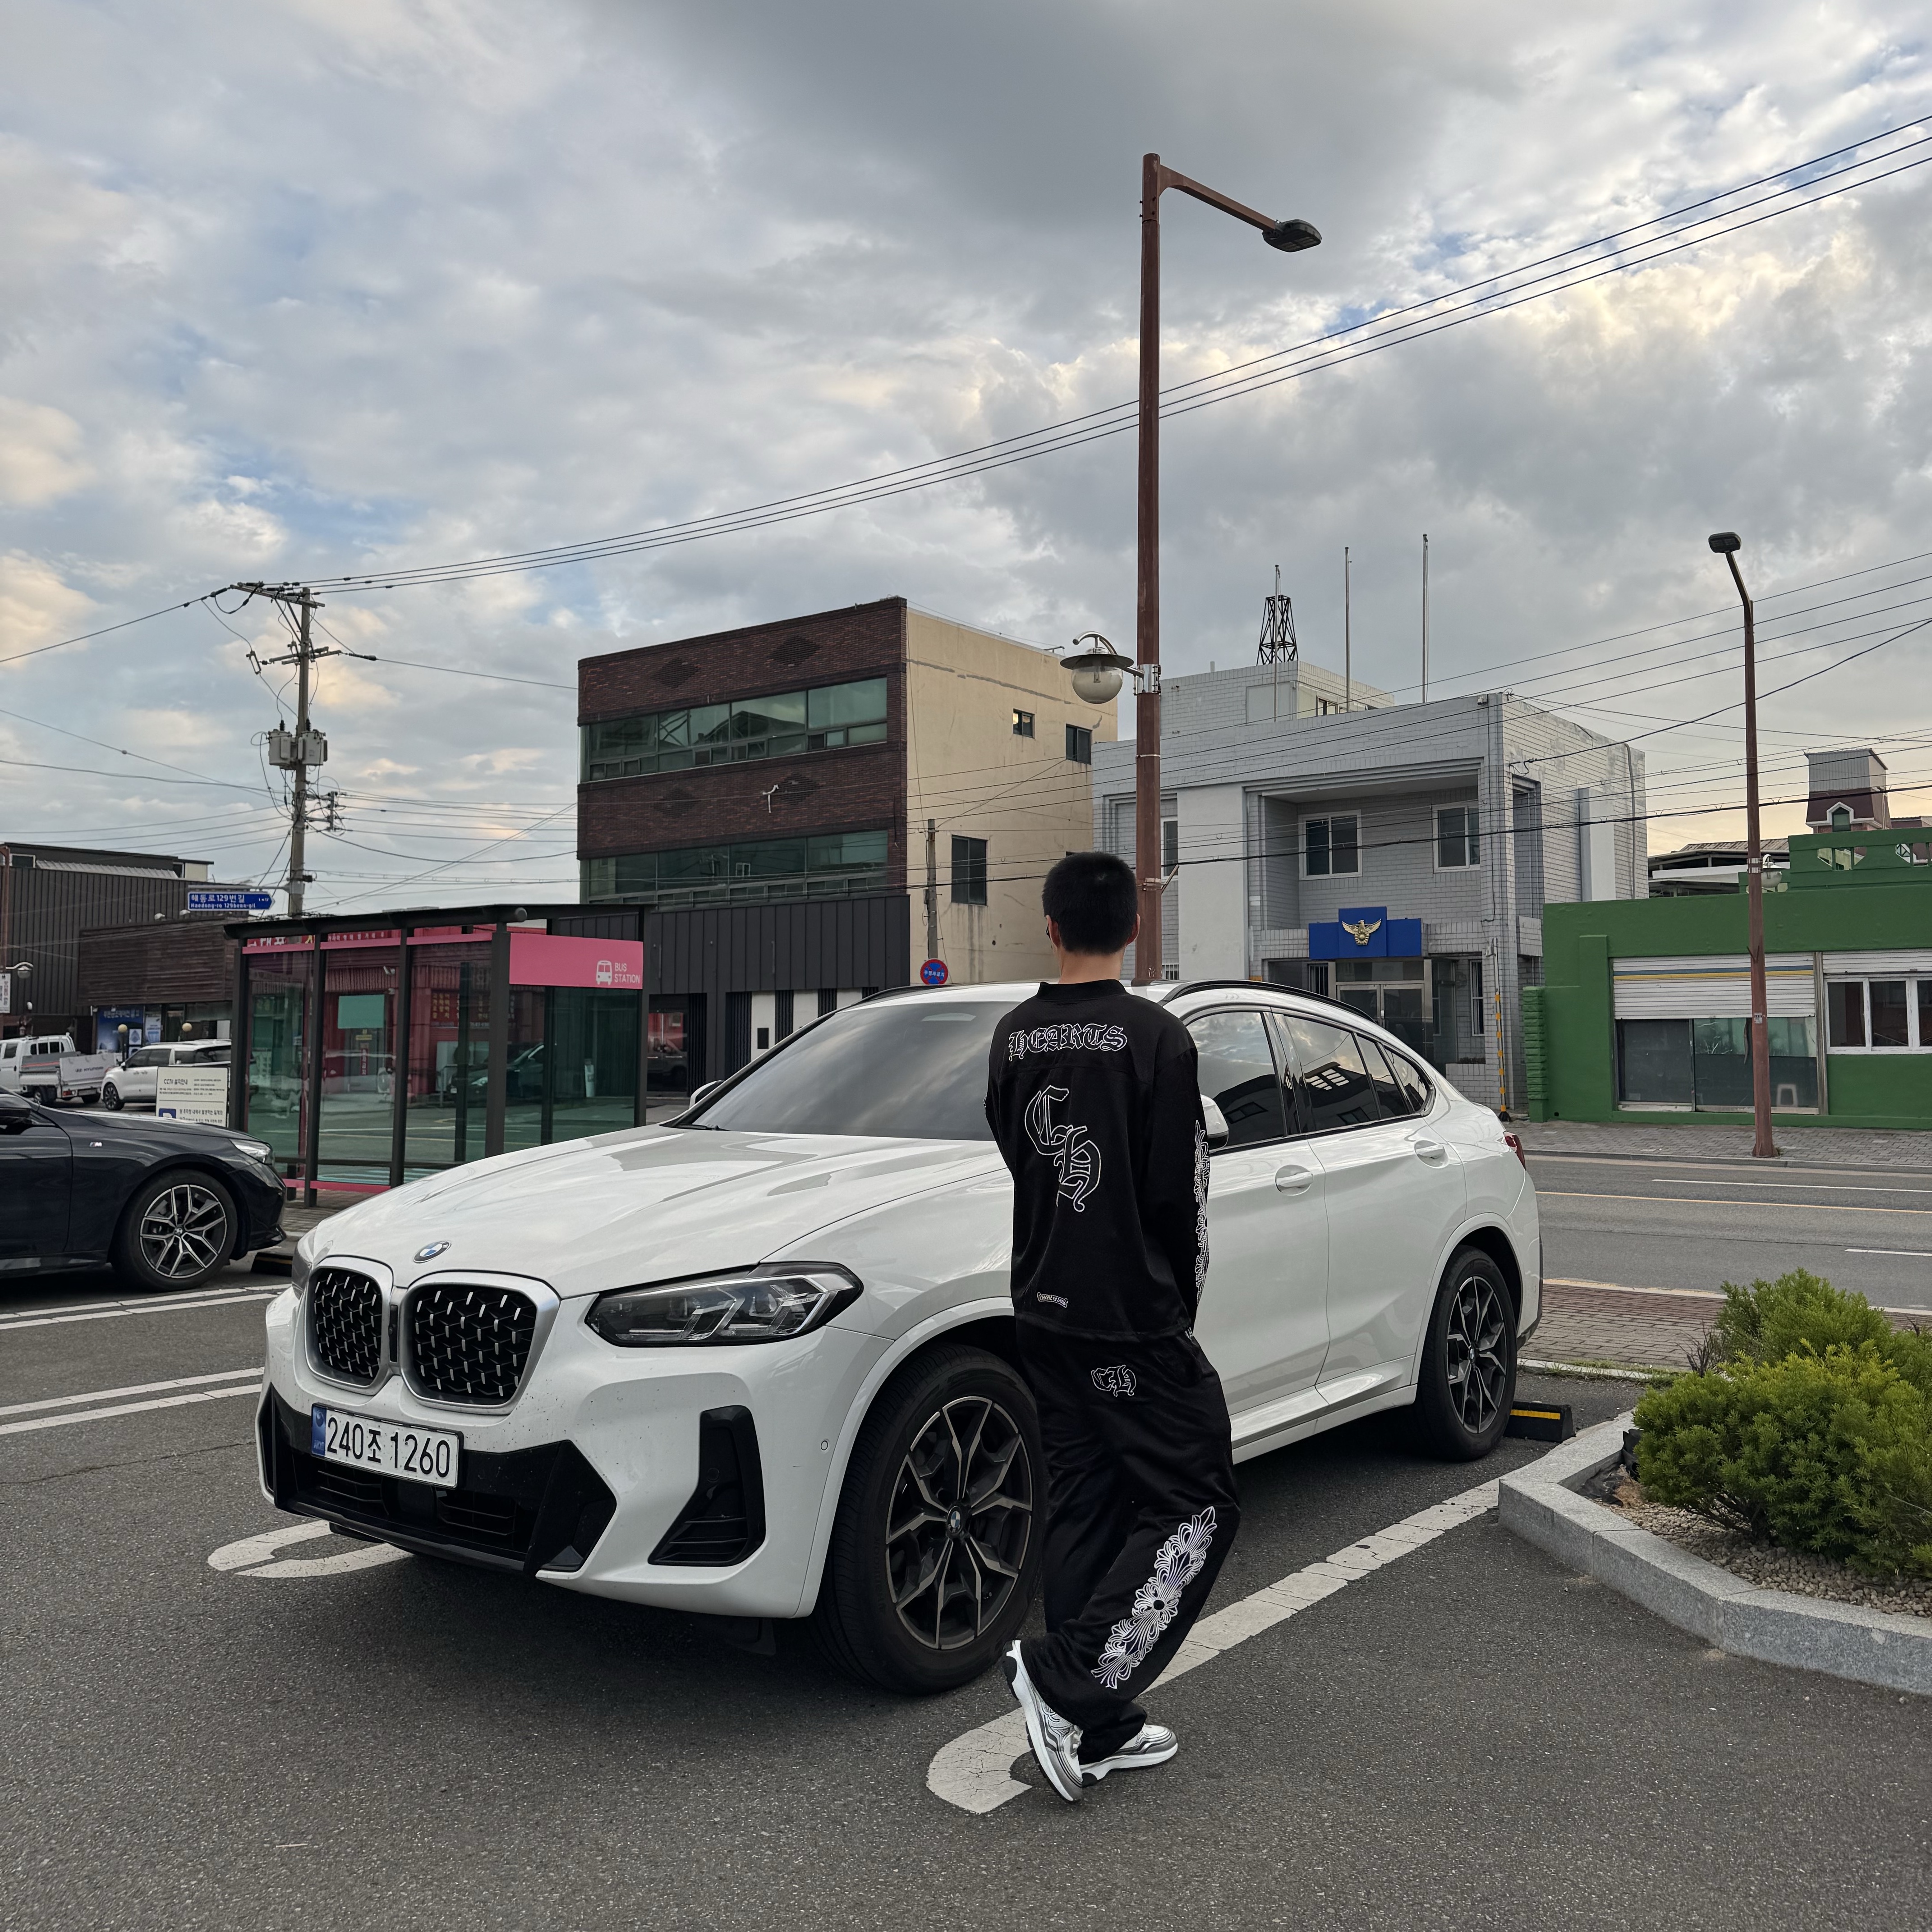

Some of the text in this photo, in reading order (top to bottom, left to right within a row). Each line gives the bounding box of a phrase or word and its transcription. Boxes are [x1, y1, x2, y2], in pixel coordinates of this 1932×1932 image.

[614, 973, 640, 984] STATION
[615, 963, 627, 972] BUS
[1008, 1023, 1127, 1061] HEARTS
[327, 1417, 450, 1478] 240조 1260
